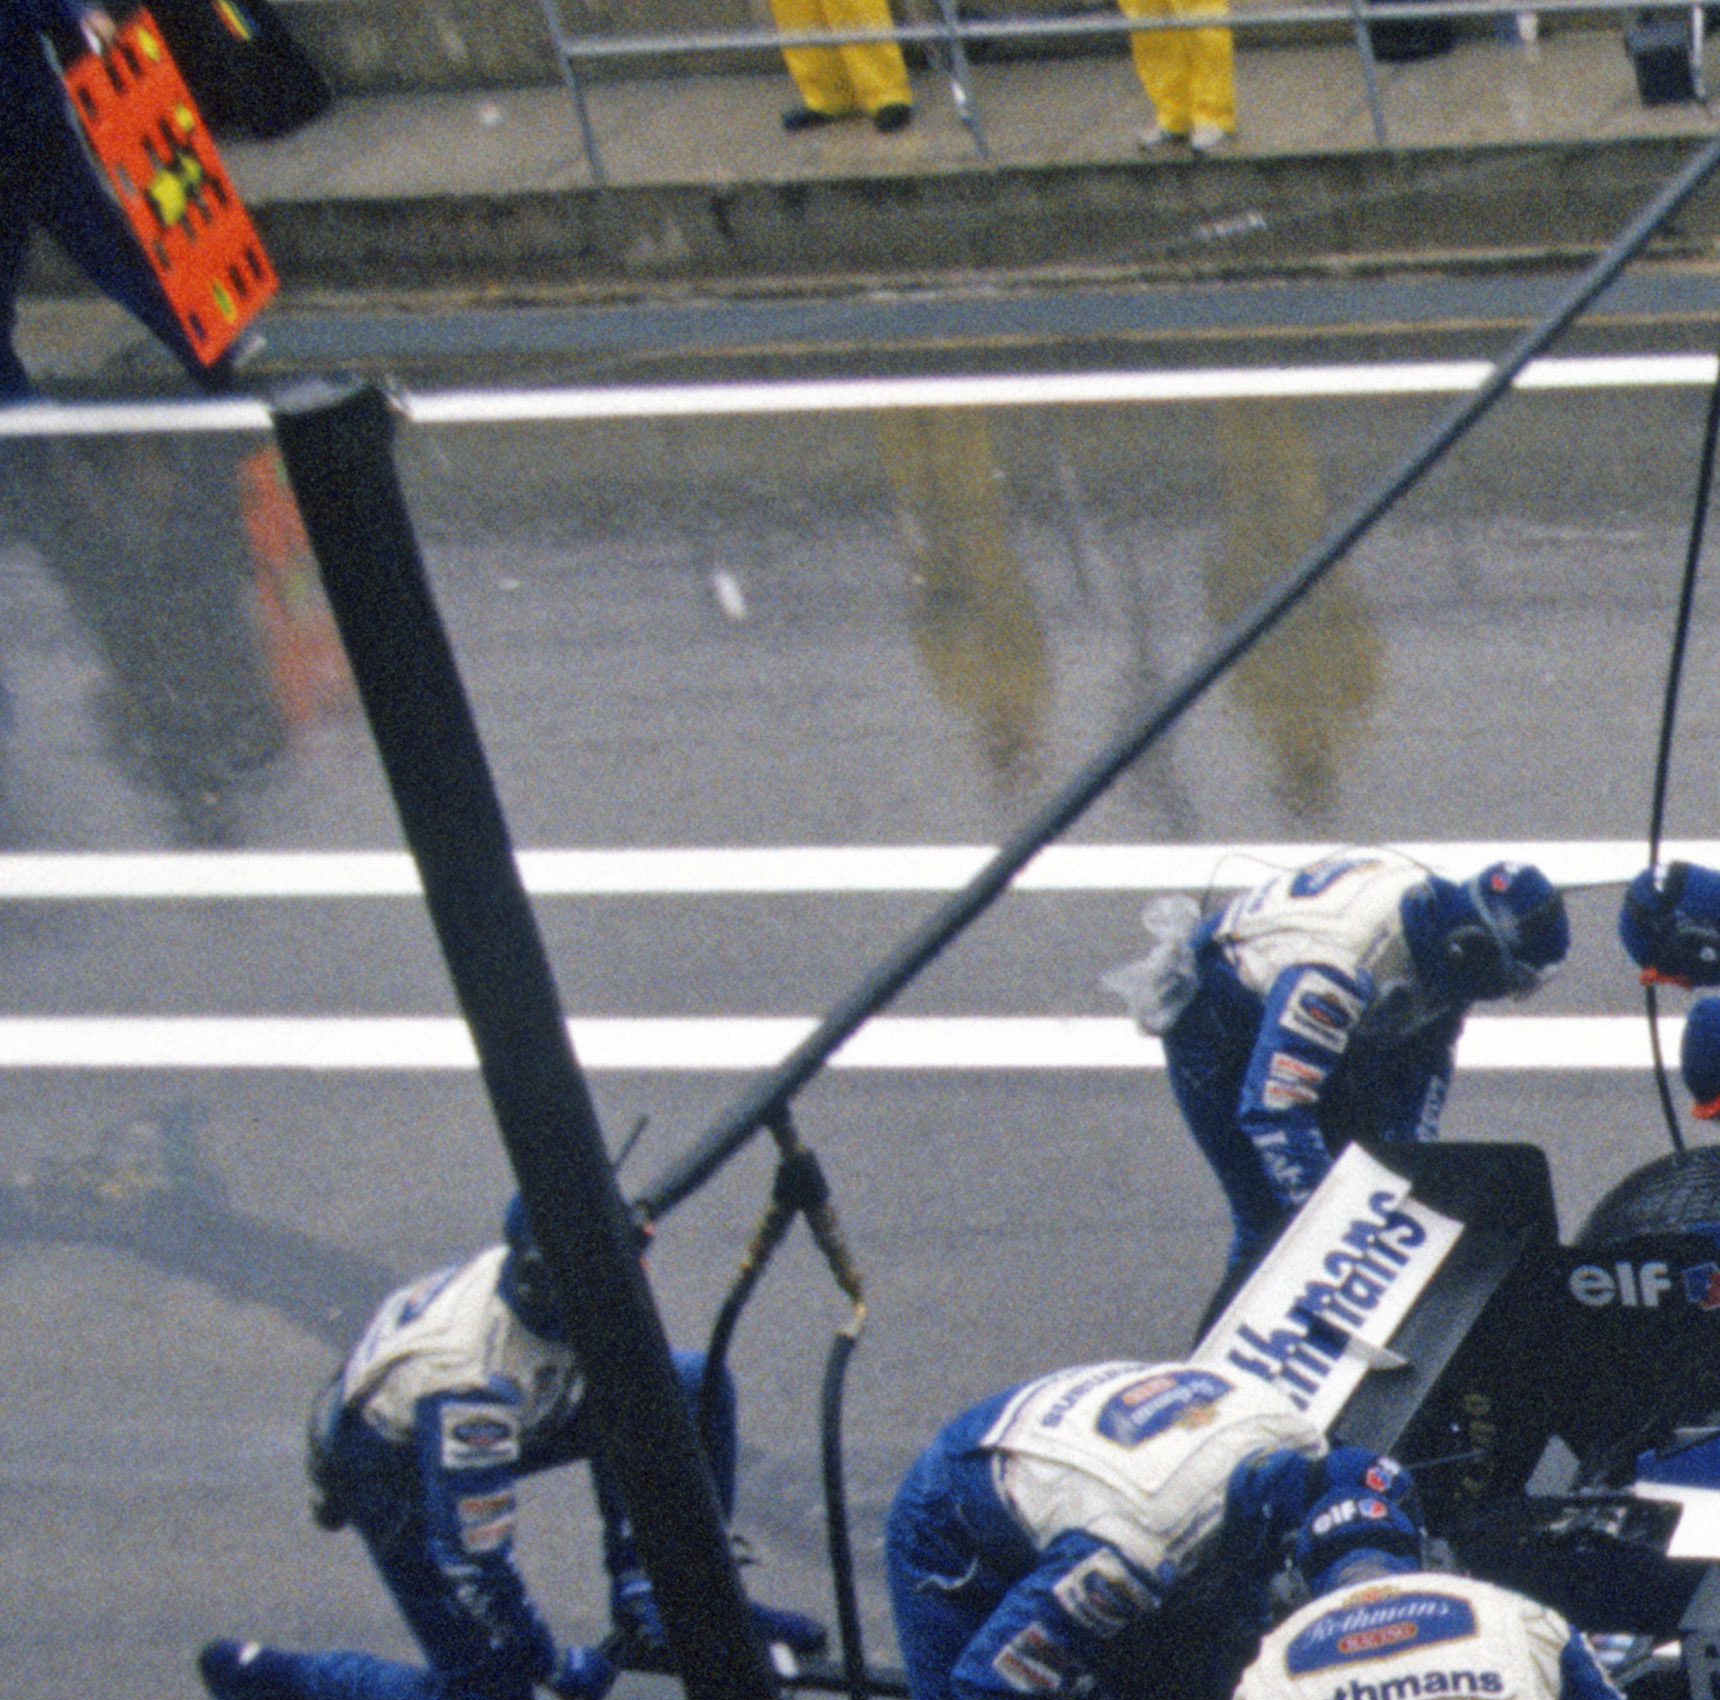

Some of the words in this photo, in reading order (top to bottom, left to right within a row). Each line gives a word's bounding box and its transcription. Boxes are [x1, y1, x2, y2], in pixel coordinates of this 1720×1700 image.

[1226, 1188, 1427, 1413] thmans
[1569, 1261, 1671, 1308] elf
[1312, 1499, 1356, 1536] elf
